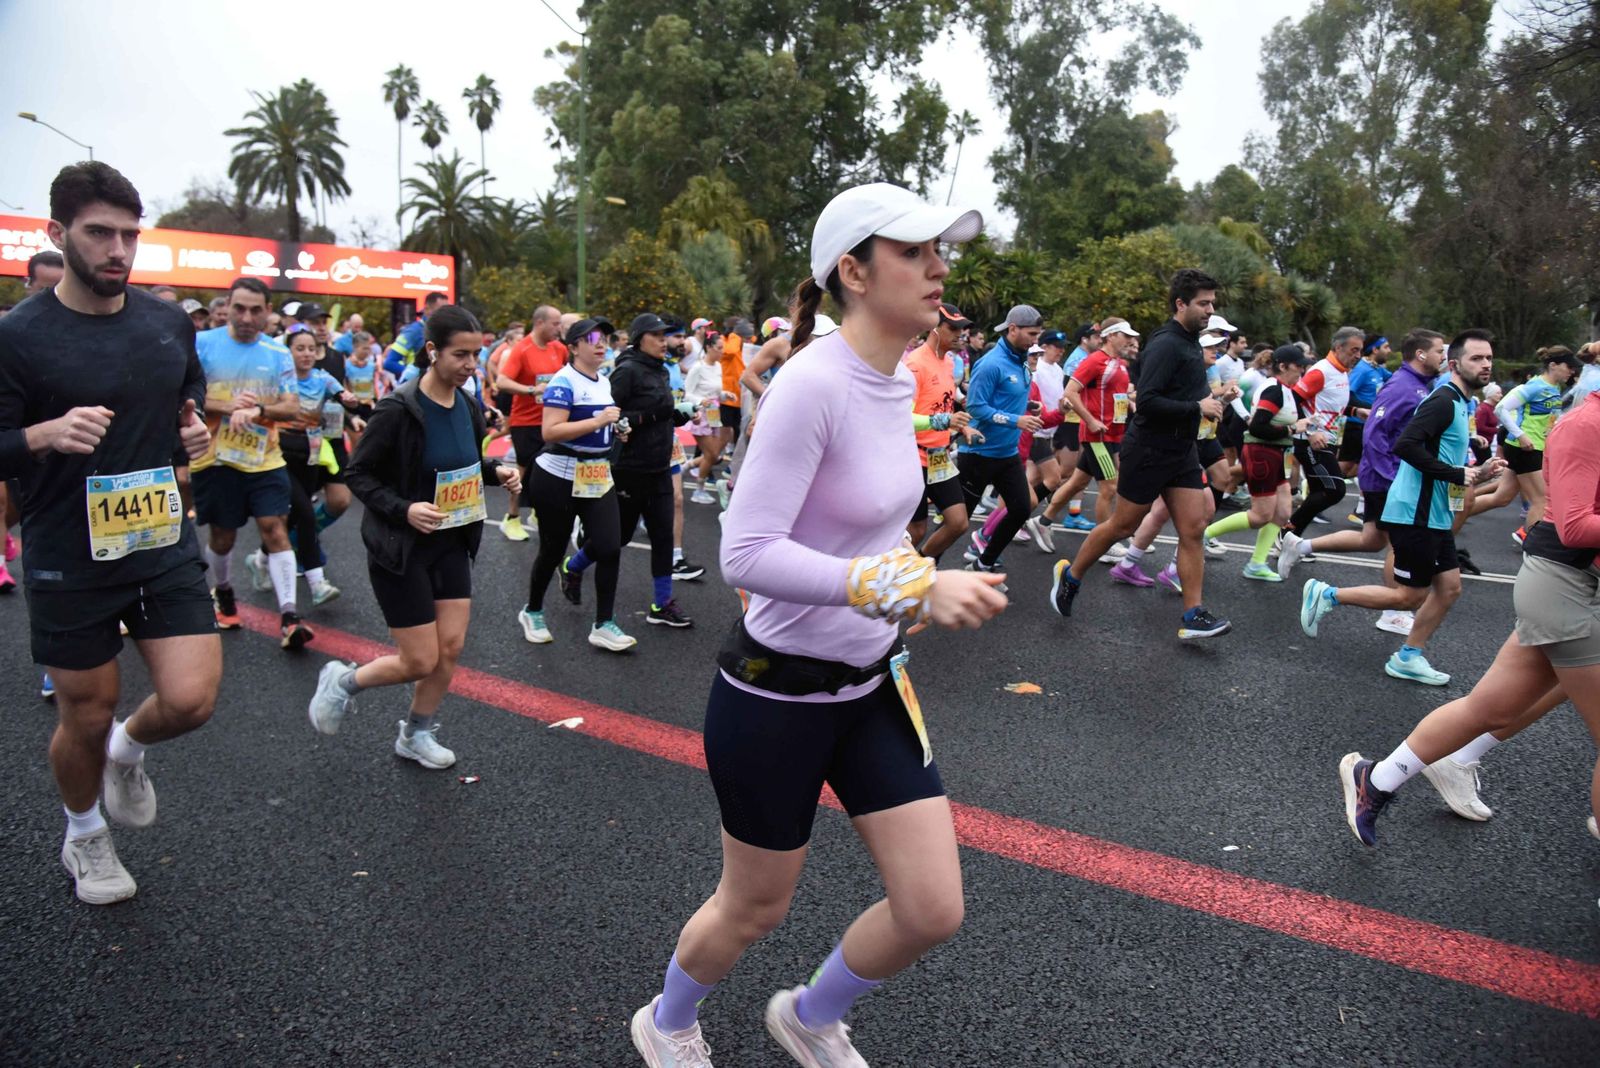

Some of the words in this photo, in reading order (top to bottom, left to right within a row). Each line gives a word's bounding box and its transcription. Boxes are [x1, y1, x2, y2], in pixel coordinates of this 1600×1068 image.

[223, 428, 259, 448] 17193
[441, 479, 479, 503] 18271
[98, 489, 166, 522] 14417
